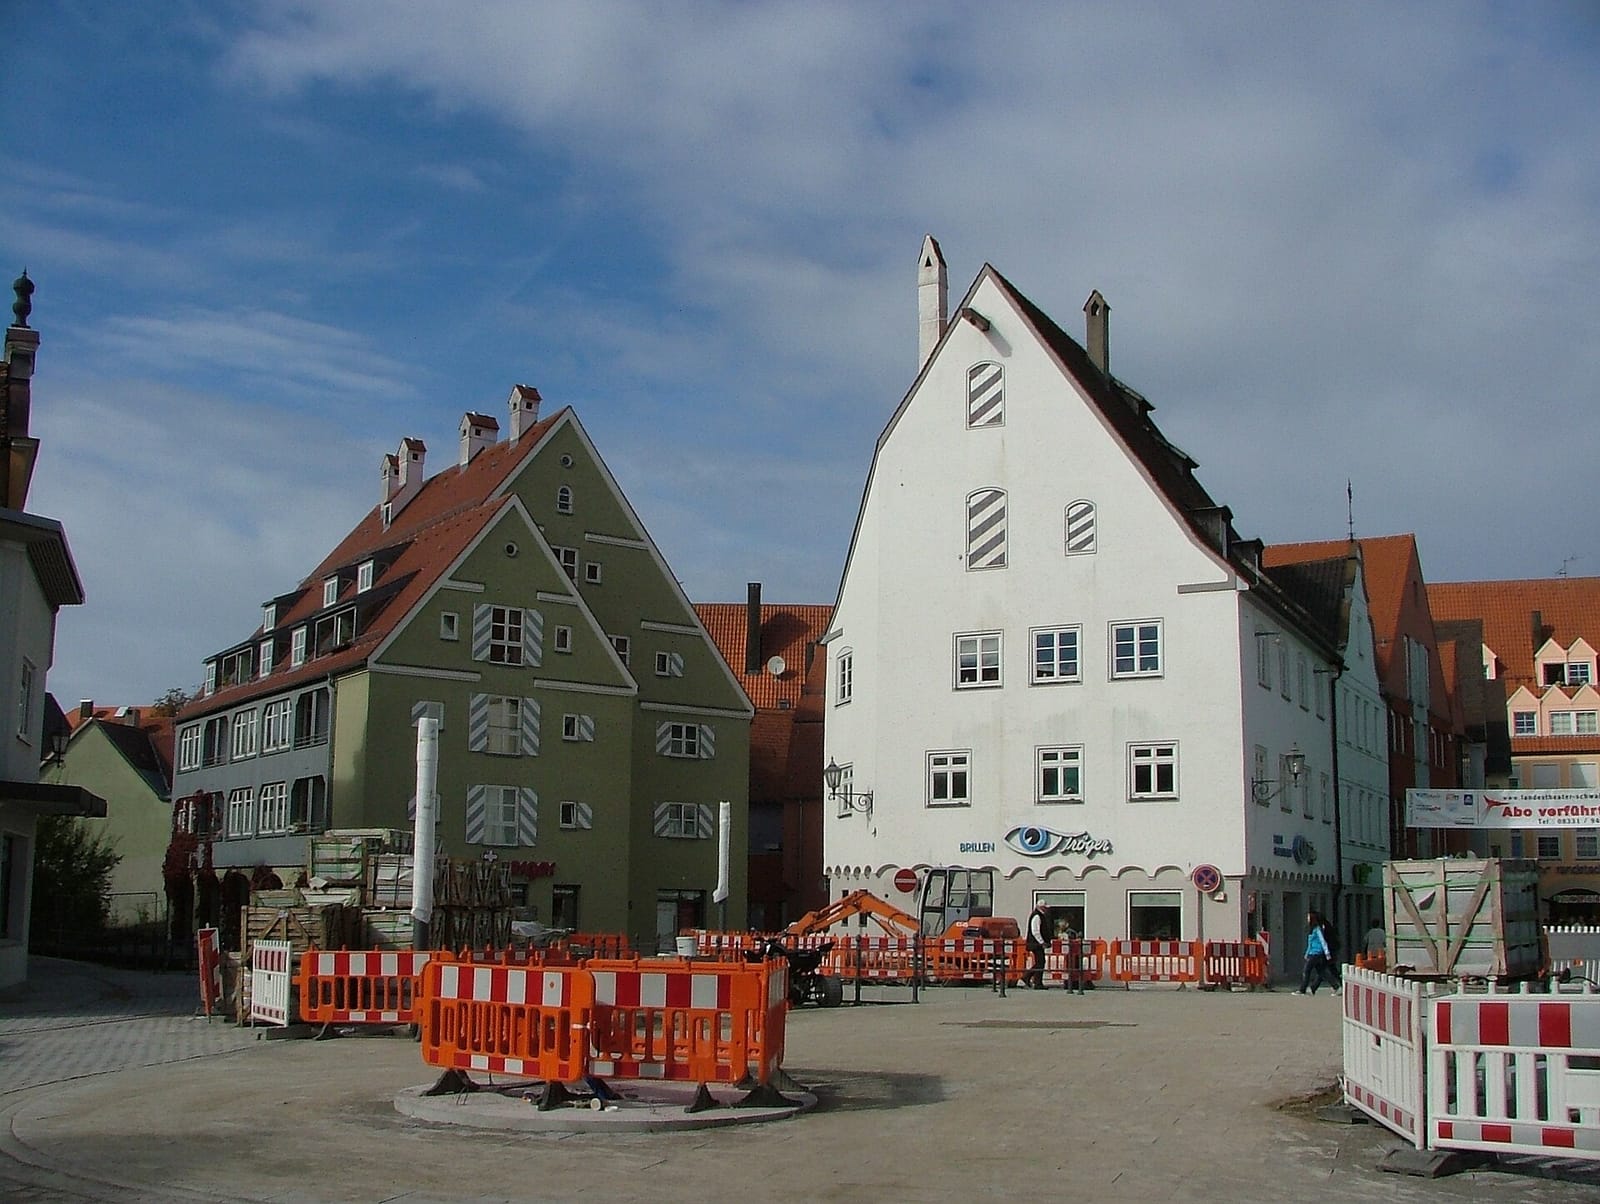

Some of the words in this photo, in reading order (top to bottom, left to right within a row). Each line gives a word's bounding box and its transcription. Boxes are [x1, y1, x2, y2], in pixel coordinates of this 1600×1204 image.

[1502, 806, 1533, 817] Abo
[959, 842, 996, 853] BRILLEN
[1059, 831, 1112, 858] Tröger
